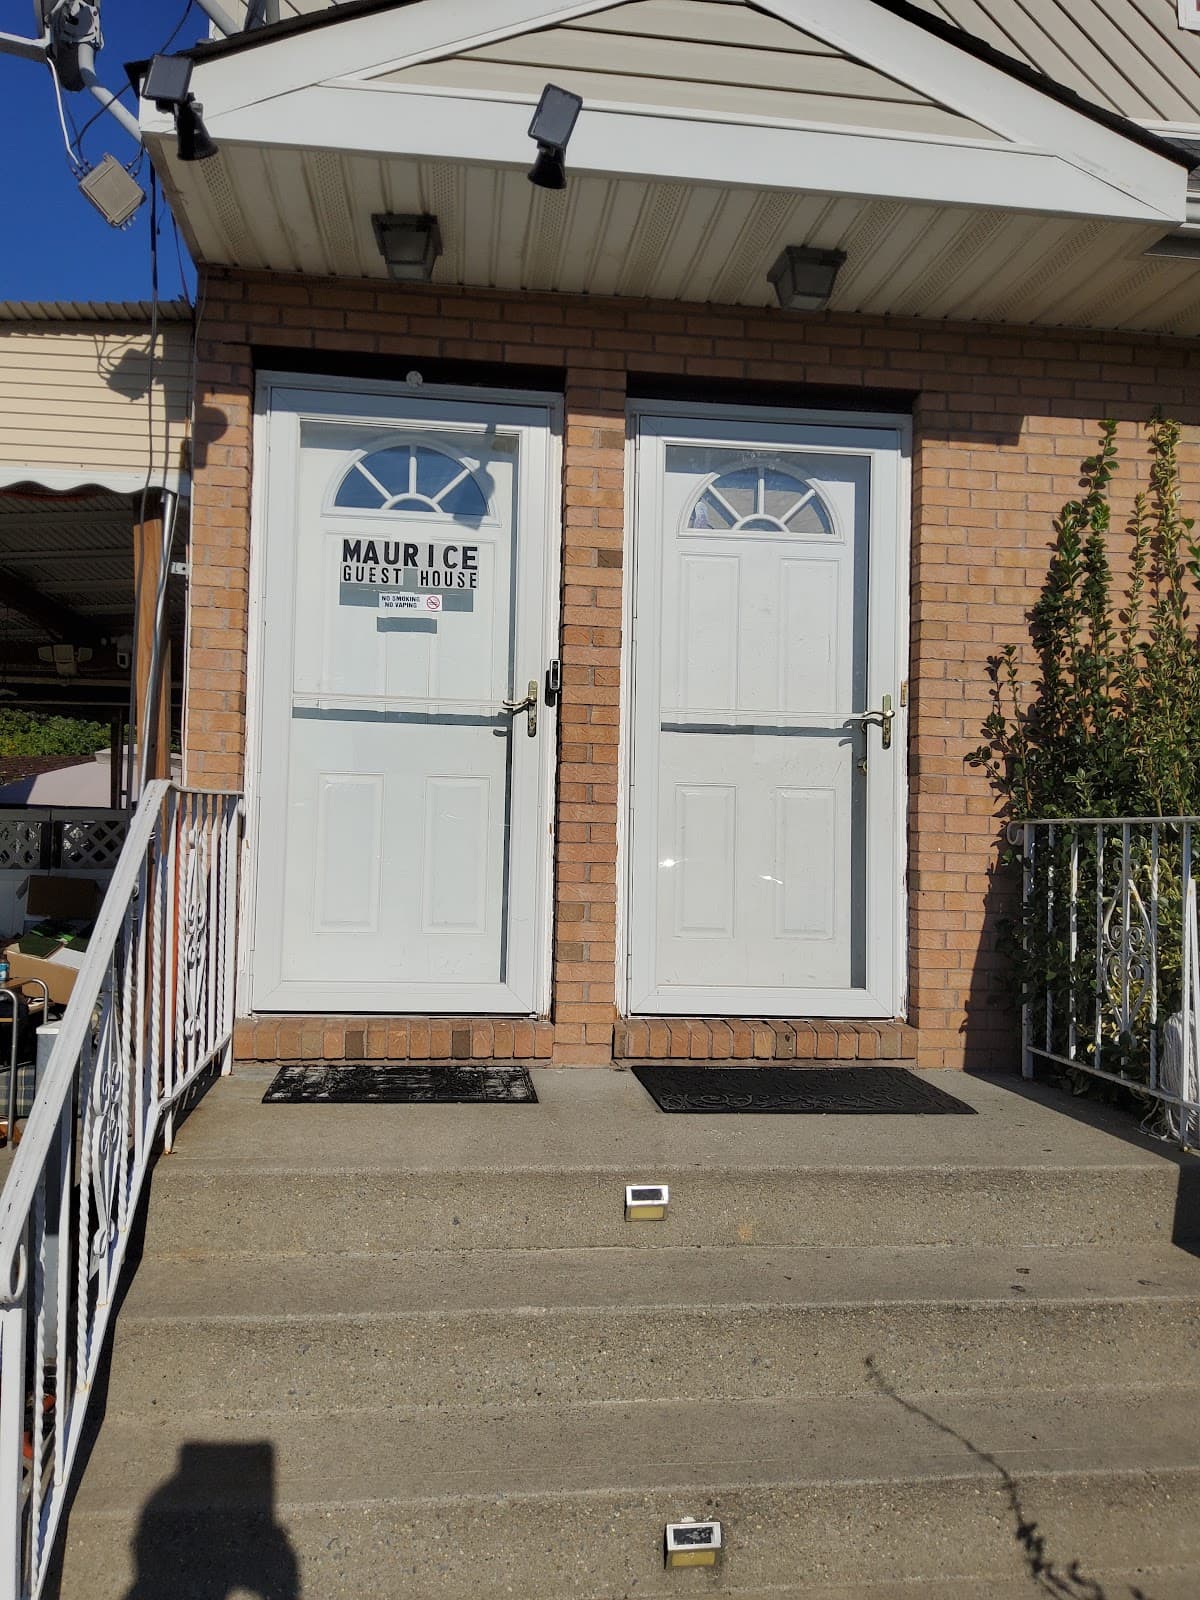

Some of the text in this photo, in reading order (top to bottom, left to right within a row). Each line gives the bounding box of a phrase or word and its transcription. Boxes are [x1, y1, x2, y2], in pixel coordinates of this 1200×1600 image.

[342, 539, 478, 570] MAURICE
[343, 565, 477, 588] GUEST HOUSE
